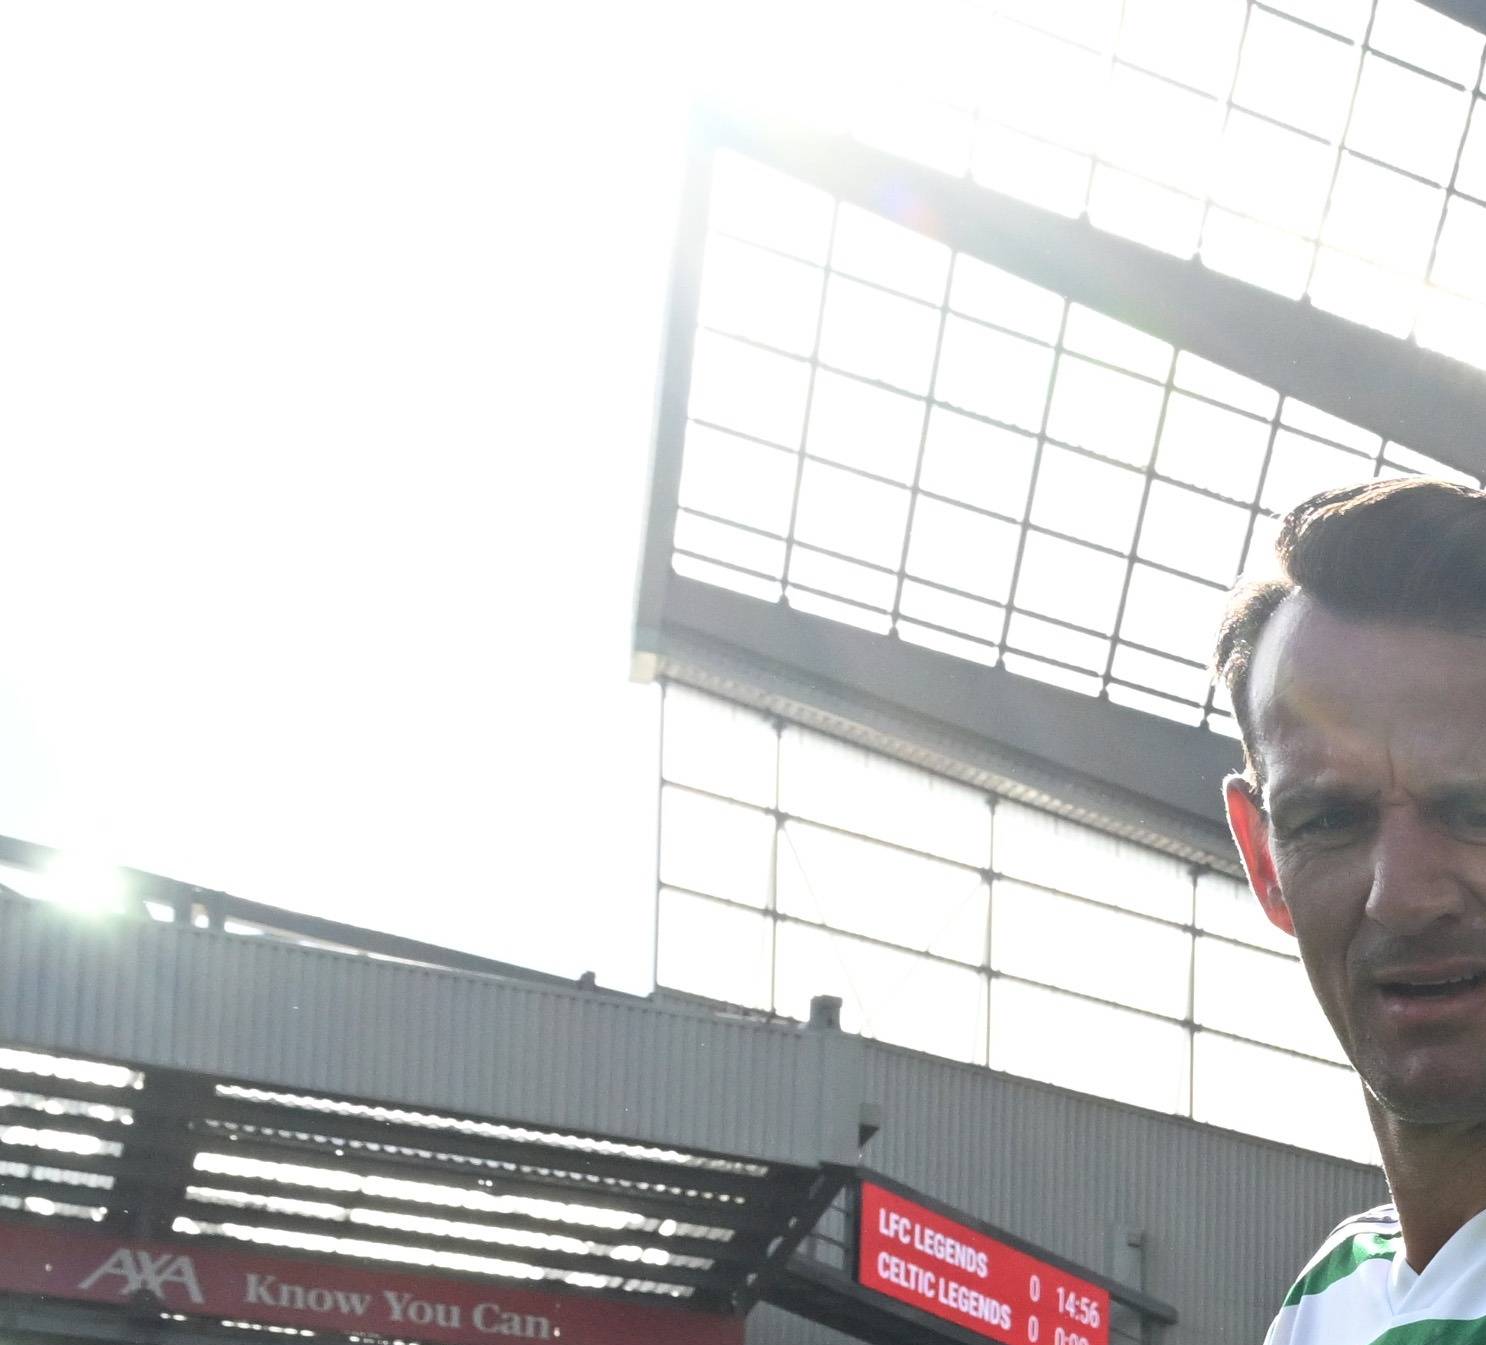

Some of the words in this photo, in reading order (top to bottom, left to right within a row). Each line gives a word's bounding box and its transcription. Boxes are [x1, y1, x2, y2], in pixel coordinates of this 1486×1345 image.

[77, 1248, 205, 1304] AXA
[243, 1273, 373, 1317] Know
[371, 1290, 461, 1330] You
[473, 1303, 550, 1340] Can
[877, 1252, 936, 1298] CELTIC
[938, 1278, 1012, 1331] LEGENDS
[1027, 1316, 1039, 1343] 0
[878, 1208, 911, 1244] LFC
[914, 1223, 989, 1279] LEGENDS
[1029, 1275, 1041, 1303] 0
[1056, 1287, 1100, 1328] 14:56
